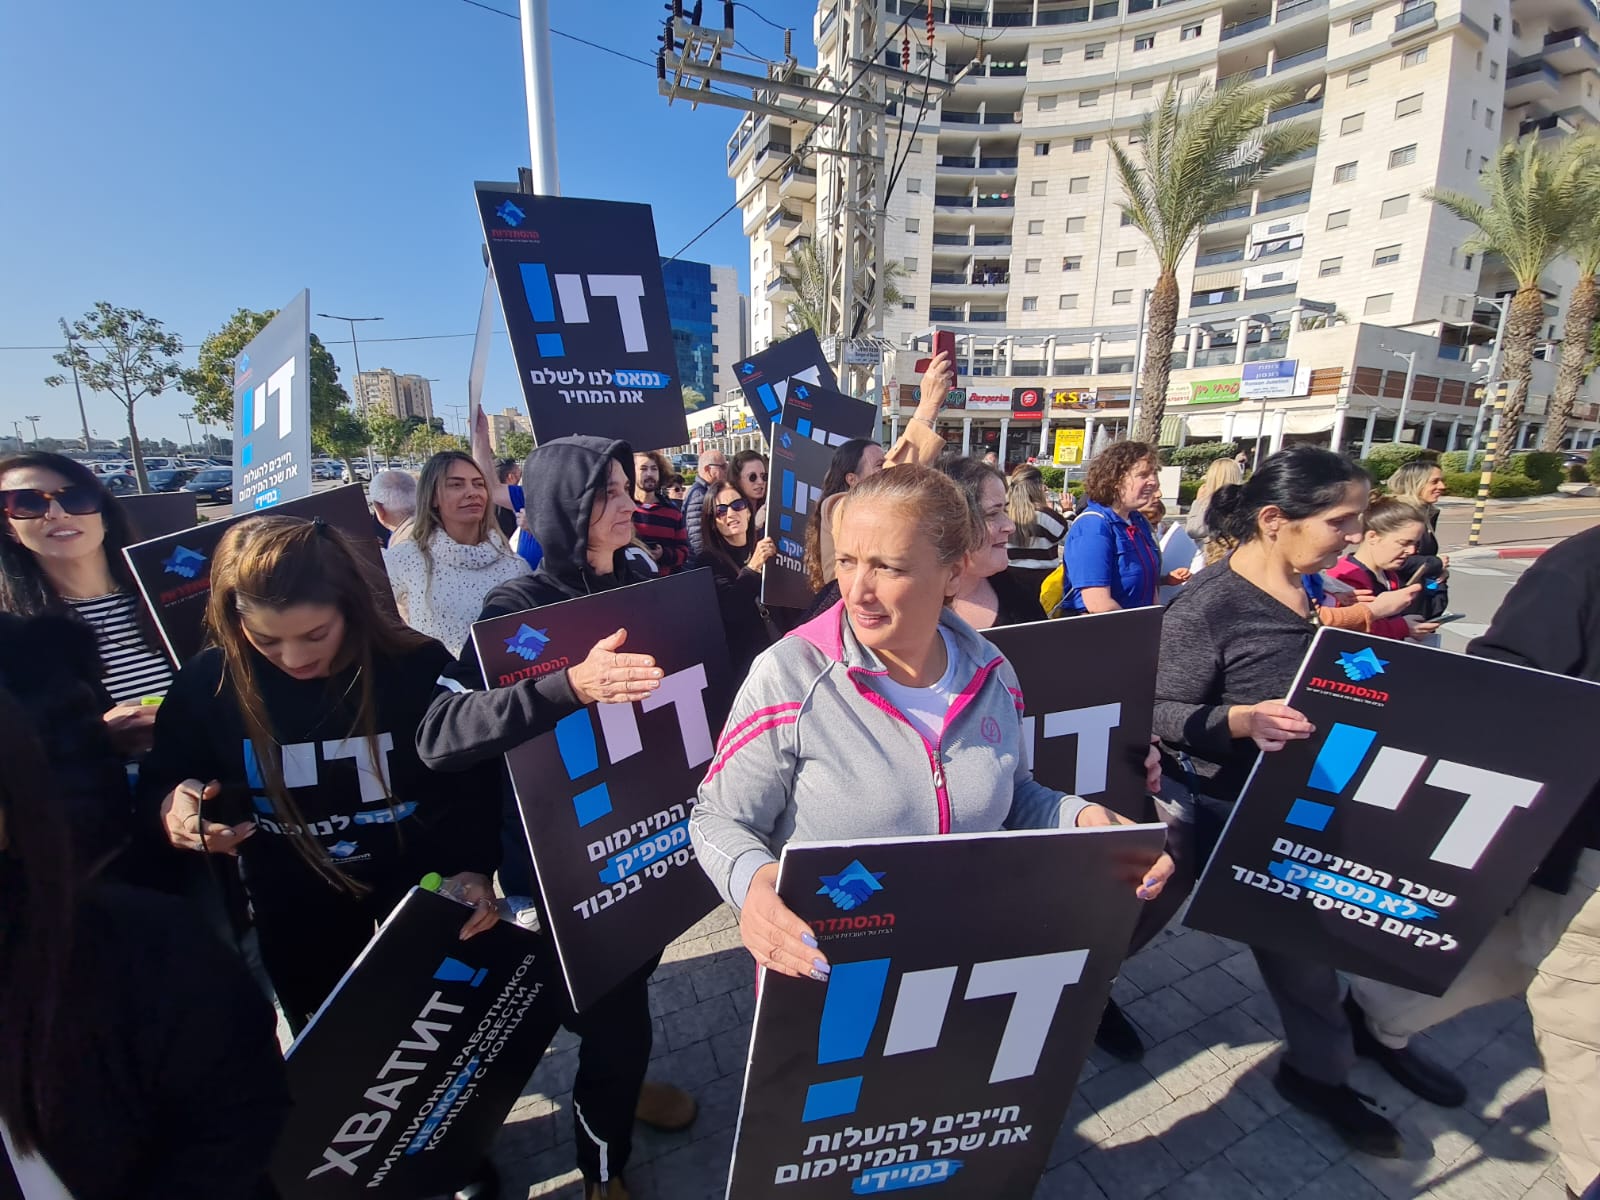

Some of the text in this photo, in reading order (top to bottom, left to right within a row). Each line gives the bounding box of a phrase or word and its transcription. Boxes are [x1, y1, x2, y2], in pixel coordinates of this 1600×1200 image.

[518, 263, 649, 358] די!
[530, 367, 661, 386] נמאס לנו לשלם
[558, 390, 644, 404] את המחיר
[1055, 391, 1090, 404] KSP
[242, 356, 295, 468] די!
[239, 464, 298, 502] את שכר המינימום
[243, 451, 292, 486] חייבים להעלות
[256, 490, 277, 507] במיידי
[498, 656, 570, 687] ההסתדרות
[1309, 676, 1389, 702] ההסתדרות
[554, 662, 715, 828] די!
[1285, 722, 1544, 870] די!
[307, 814, 351, 836] לנו
[586, 804, 685, 863] המינימום
[614, 827, 687, 879] מספיק
[1272, 837, 1456, 908] שכר המינימום
[572, 877, 642, 920] בכבוד
[1231, 864, 1459, 952] לקיום בסיסי בכבוד
[1284, 864, 1418, 916] לא מספיק
[802, 948, 1090, 1122] די!
[306, 956, 489, 1180] ХВАТИТ!
[366, 954, 536, 1188] МИЛЛИОНЫ РАБОТНИКОВ
[410, 986, 528, 1148] НЕ МОГУТ СВЕСТИ
[424, 982, 544, 1151] КОНЦЫ С КОНЦАМИ
[774, 1124, 1032, 1184] את שכר המינימום
[802, 1104, 1020, 1156] חייבים להעלות
[860, 1160, 949, 1190] במיידי
